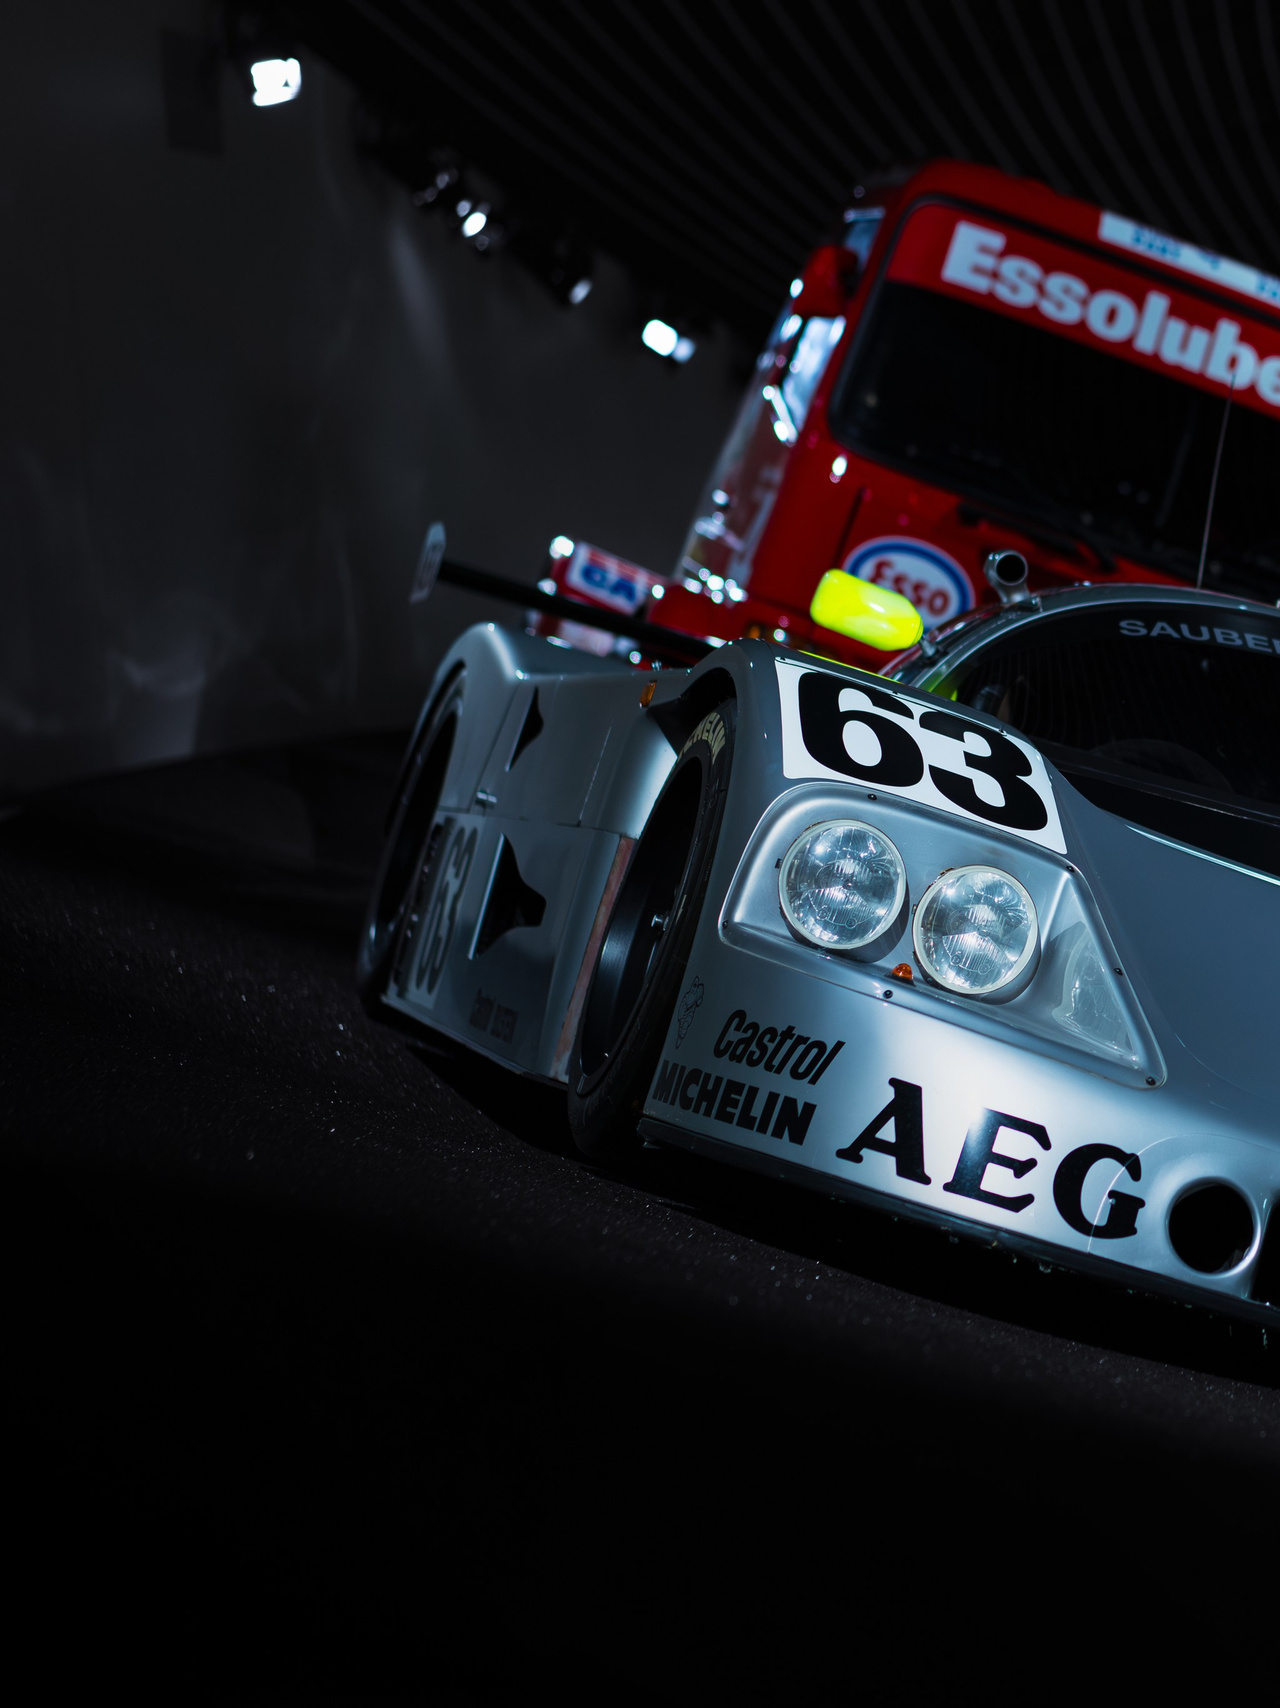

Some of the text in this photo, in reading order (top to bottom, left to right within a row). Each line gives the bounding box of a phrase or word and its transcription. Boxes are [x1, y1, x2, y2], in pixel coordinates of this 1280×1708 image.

[798, 672, 1048, 830] 63
[652, 1059, 817, 1146] MICHELIN
[713, 1009, 846, 1085] Castrol
[836, 1077, 1146, 1239] AEG
